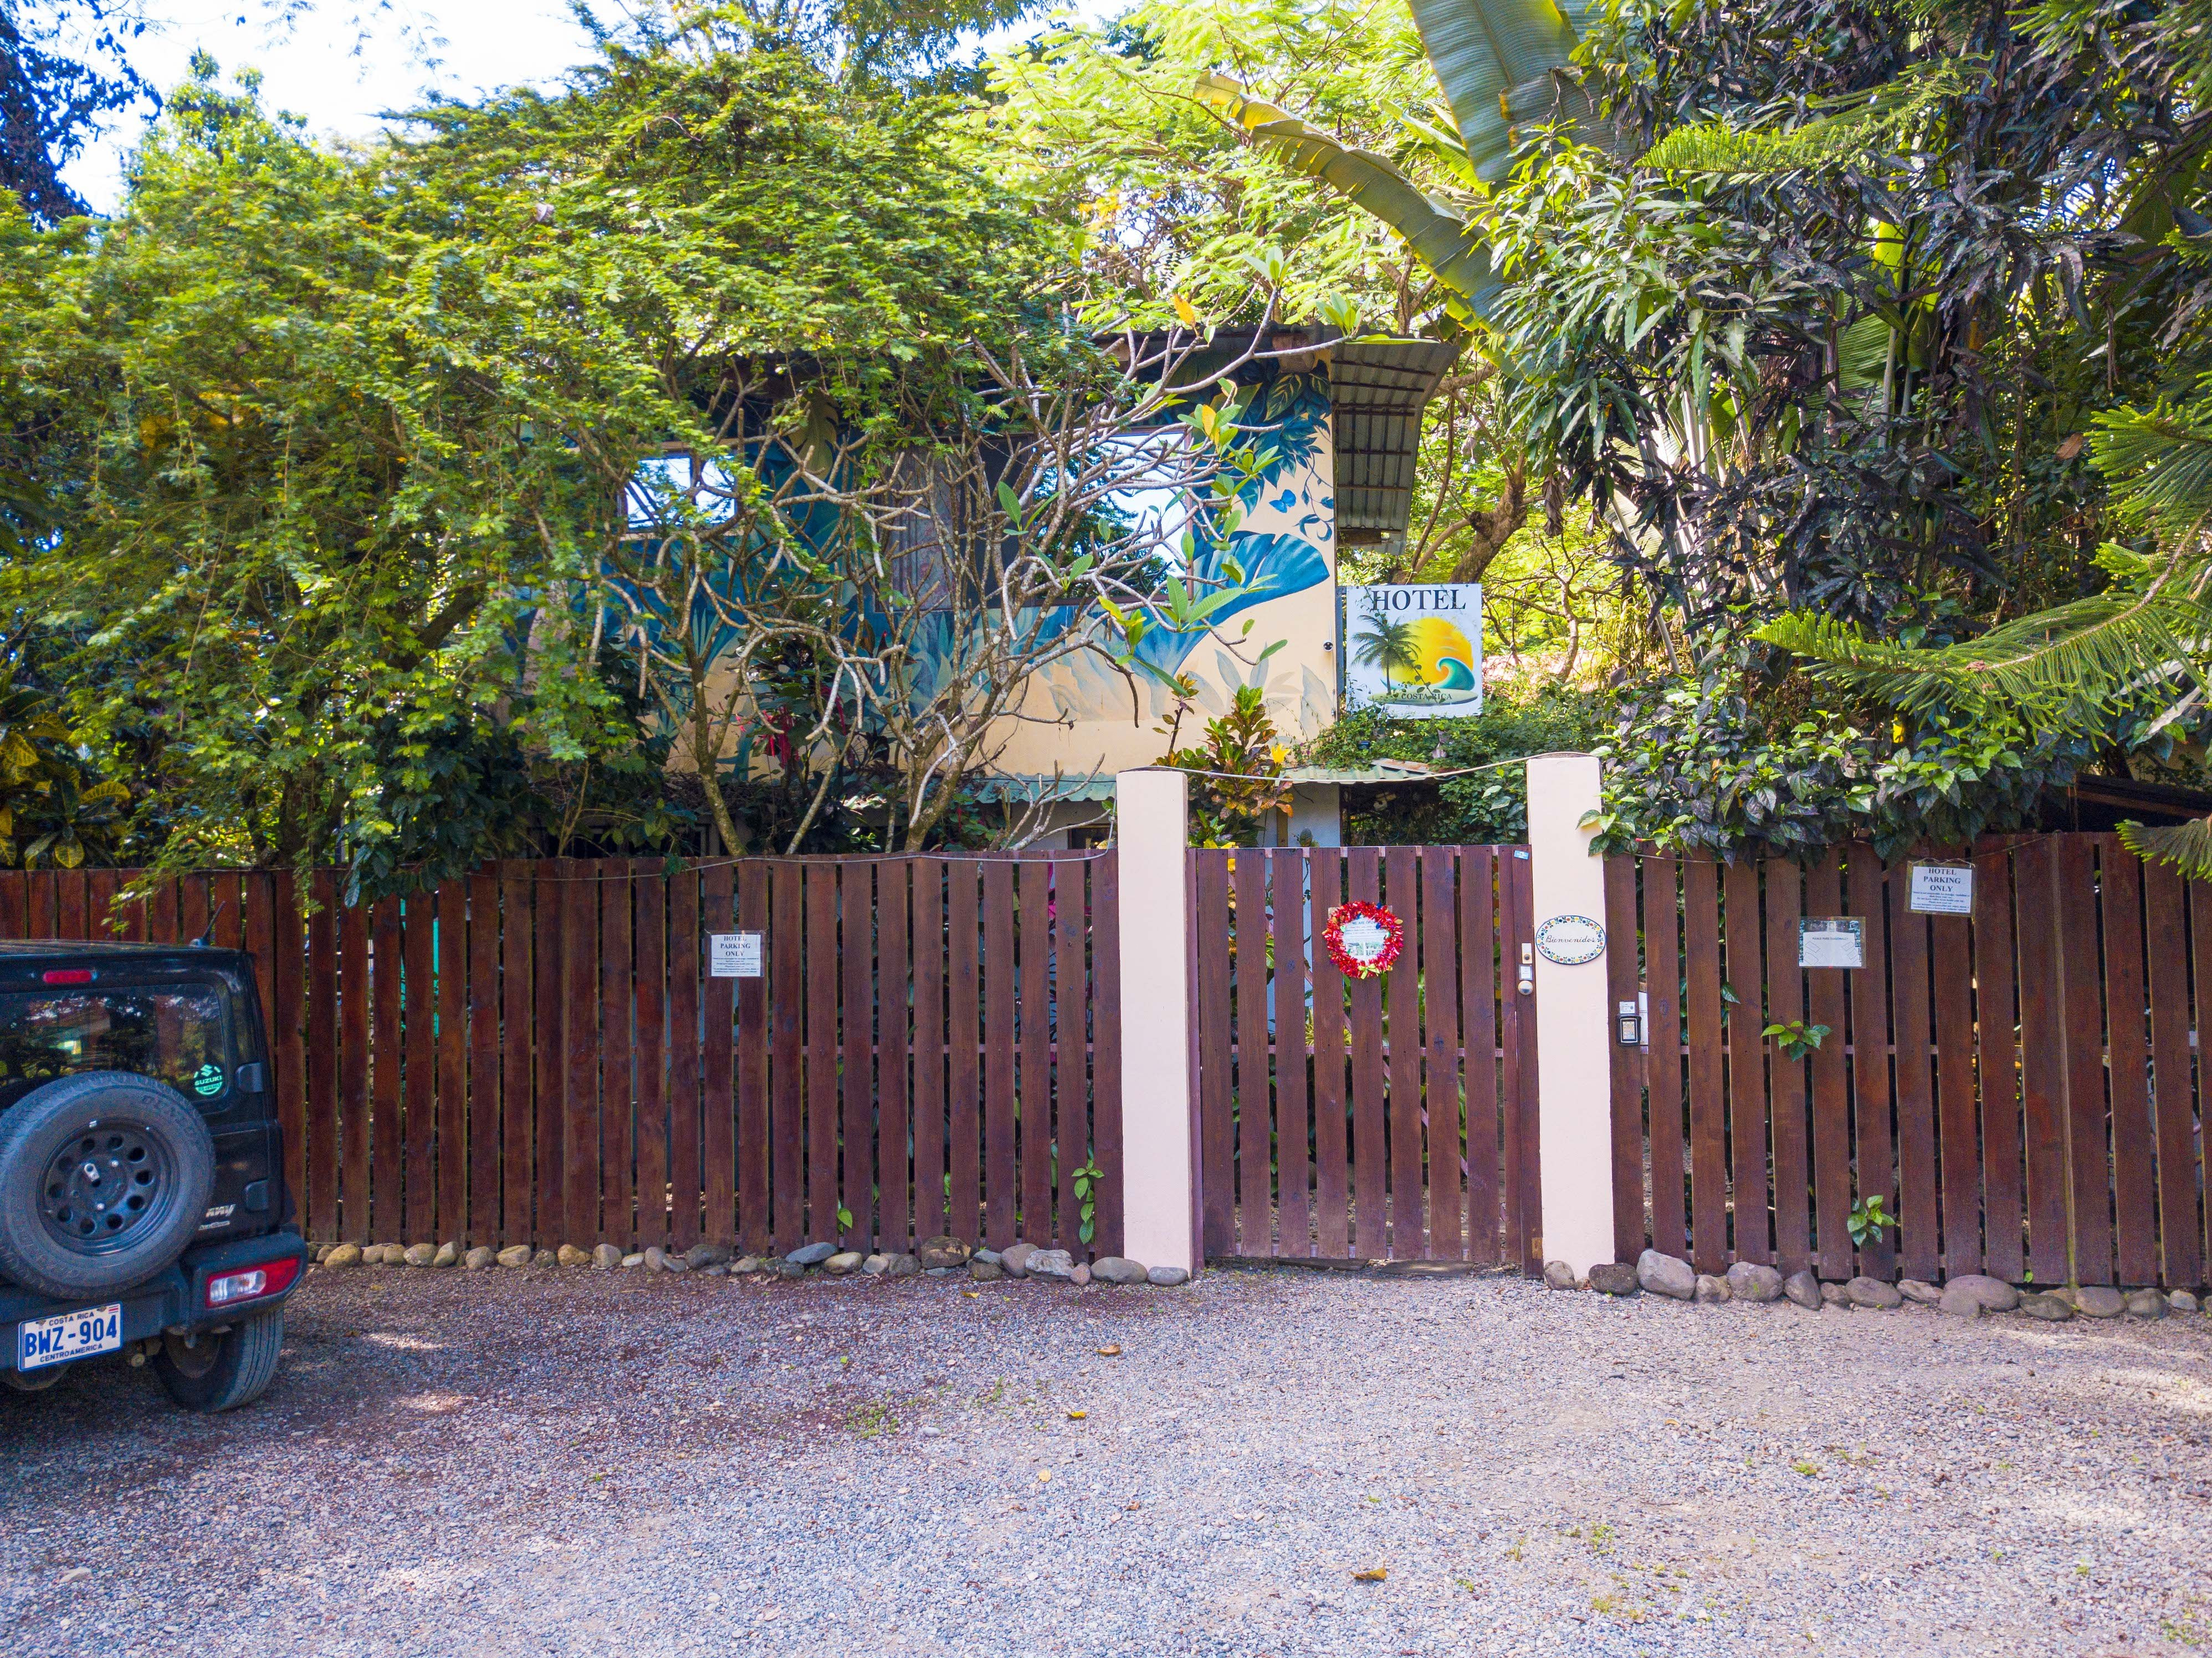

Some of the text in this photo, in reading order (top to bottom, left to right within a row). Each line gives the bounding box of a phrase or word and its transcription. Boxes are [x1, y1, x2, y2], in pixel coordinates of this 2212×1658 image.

[1371, 589, 1466, 611] HOTEL
[1923, 876, 1961, 884] PARKING
[194, 1075, 222, 1086] SUZUKI
[49, 1311, 94, 1326] COSTA RICA
[24, 1314, 117, 1358] BWZ-904
[40, 1343, 103, 1363] CENTROAMERICA
